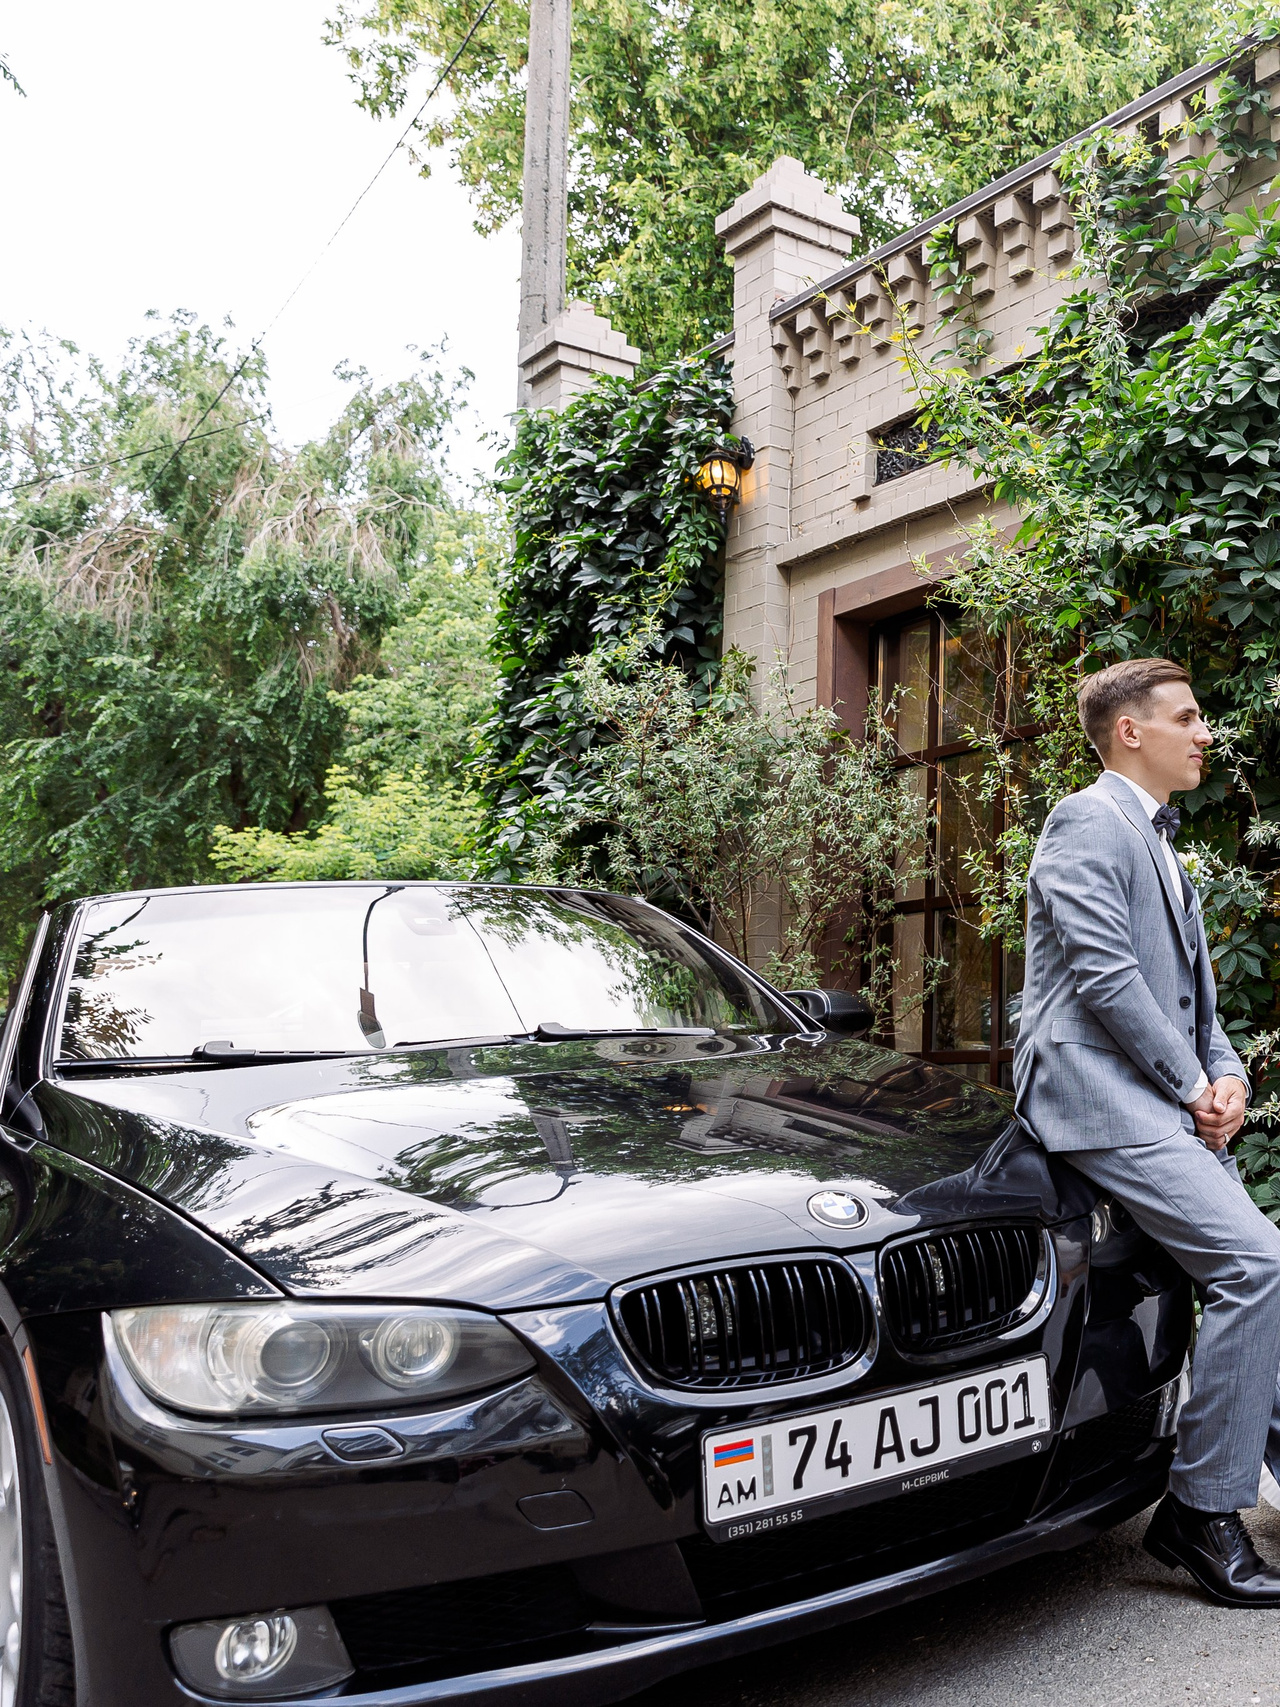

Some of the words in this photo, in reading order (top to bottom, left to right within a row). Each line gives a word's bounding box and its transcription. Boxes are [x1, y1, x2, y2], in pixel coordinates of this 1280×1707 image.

[788, 1418, 852, 1490] 74
[873, 1395, 941, 1469] AJ
[957, 1371, 1036, 1444] 001
[717, 1476, 757, 1509] AM
[901, 1469, 950, 1491] М-СЕРВИС
[728, 1522, 754, 1538] (351)
[755, 1517, 774, 1531] 281
[776, 1513, 789, 1526] 55
[790, 1509, 803, 1521] 55
